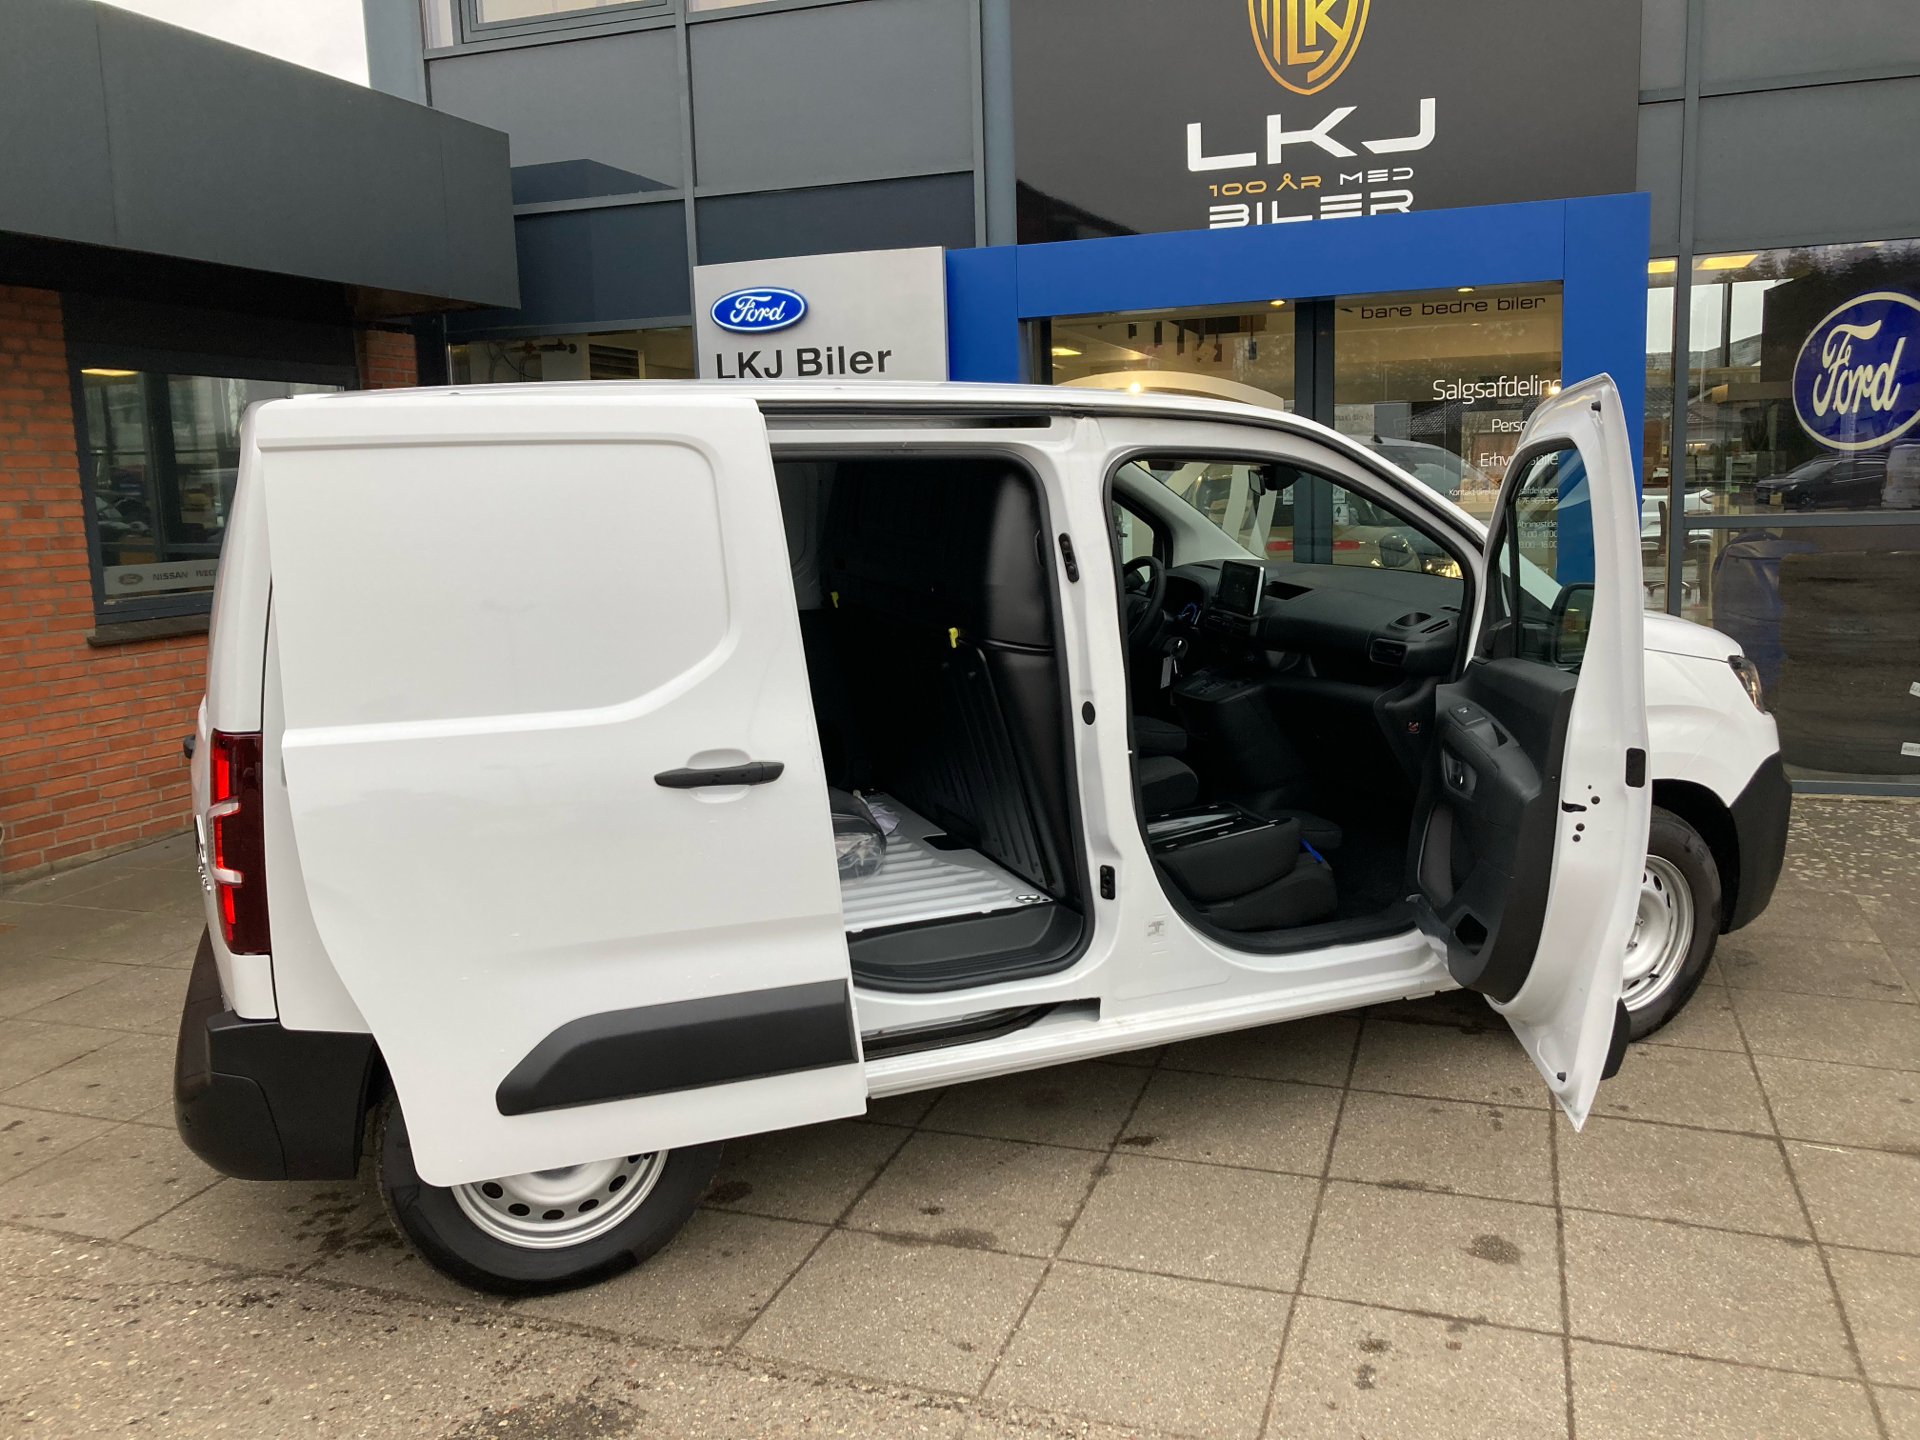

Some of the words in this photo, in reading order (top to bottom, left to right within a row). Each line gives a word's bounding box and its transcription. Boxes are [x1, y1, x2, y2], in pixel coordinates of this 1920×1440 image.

[1187, 97, 1436, 172] LKJ
[1209, 180, 1267, 197] 100
[1276, 173, 1321, 190] ÅR
[1340, 167, 1414, 186] MED
[1209, 189, 1414, 229] BILER
[729, 295, 787, 324] Ford
[1361, 305, 1412, 319] bare
[1421, 300, 1488, 315] bedre
[1497, 296, 1546, 311] biler
[716, 350, 783, 378] LKJ
[796, 346, 892, 377] Biler
[1812, 319, 1908, 418] Ford
[152, 571, 189, 581] NISSAN
